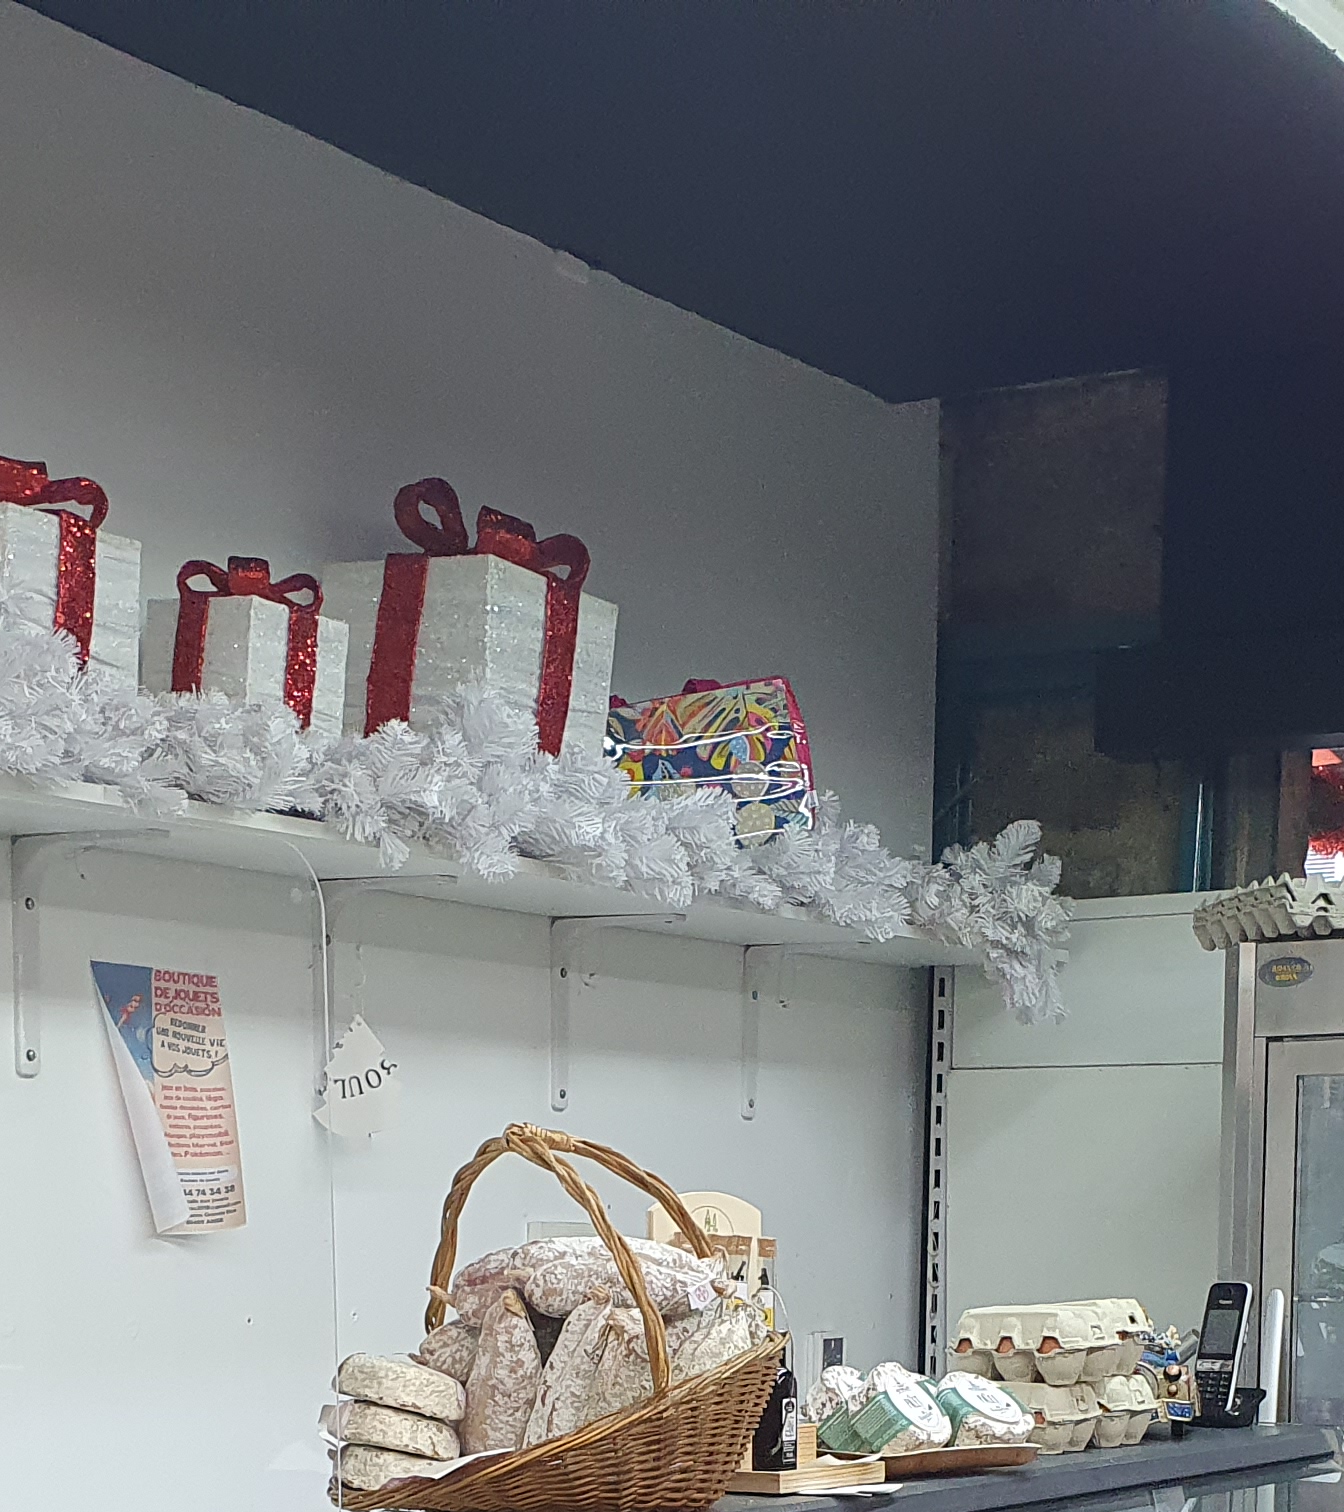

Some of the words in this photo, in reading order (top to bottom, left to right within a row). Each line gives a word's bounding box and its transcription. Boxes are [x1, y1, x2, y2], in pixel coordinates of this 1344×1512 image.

[154, 969, 218, 988] BOUTIQUE
[154, 986, 171, 999] DE
[171, 988, 220, 1004] JOUETS
[167, 1042, 180, 1053] VOS
[172, 1030, 207, 1046] NOUVELLE
[209, 1038, 225, 1048] VIE
